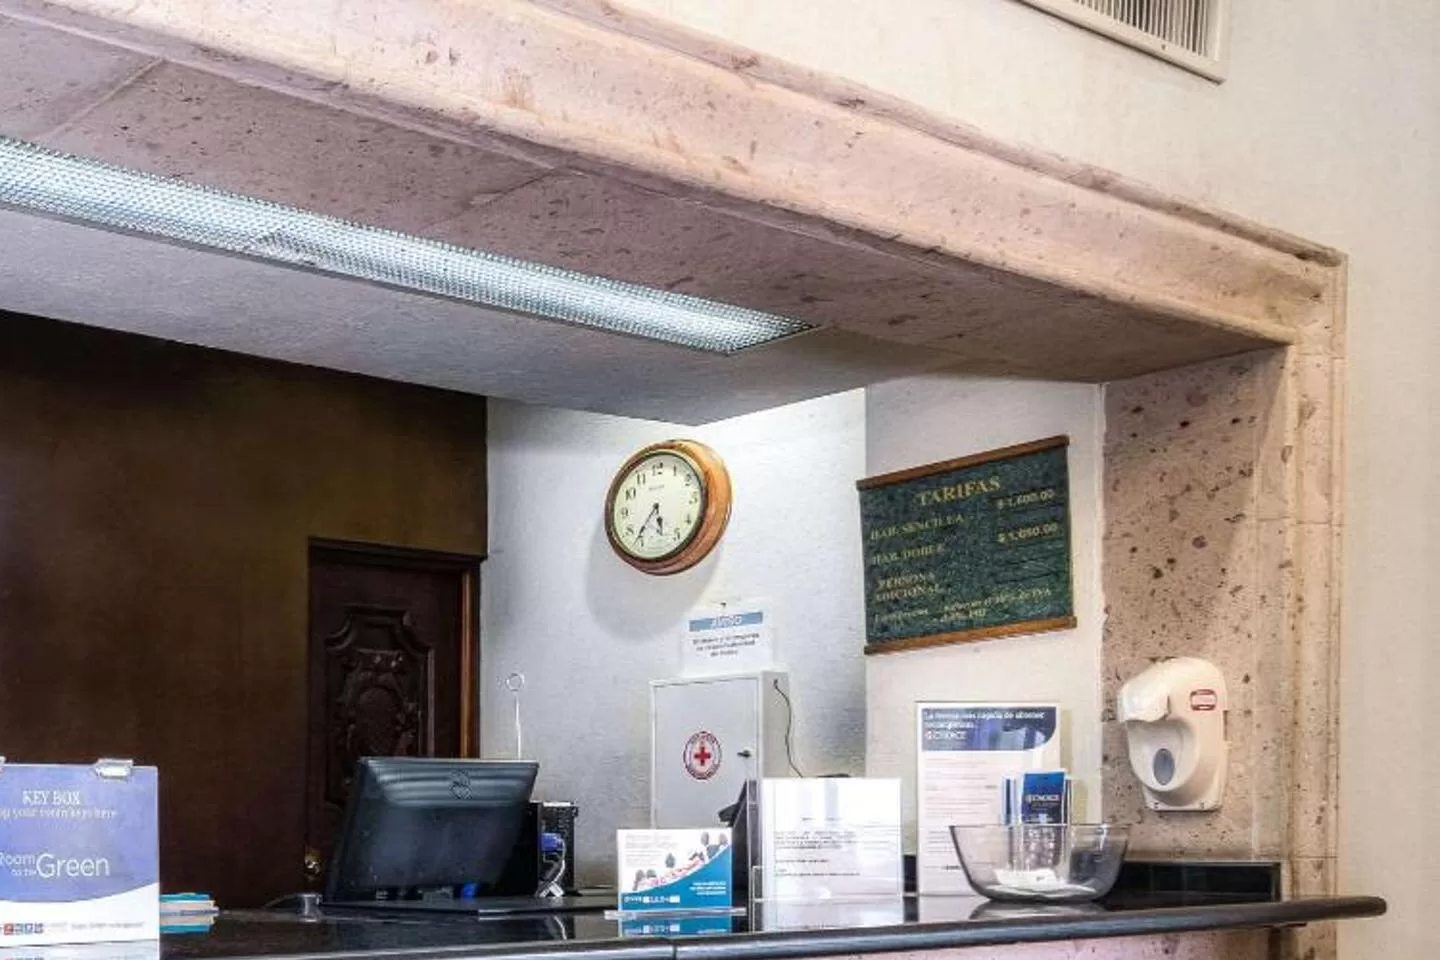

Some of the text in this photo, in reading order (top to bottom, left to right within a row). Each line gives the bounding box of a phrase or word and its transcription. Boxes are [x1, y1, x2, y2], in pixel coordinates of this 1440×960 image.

[917, 475, 1001, 507] TARIFAS
[22, 790, 81, 806] KEY BOX
[36, 853, 110, 878] Green
